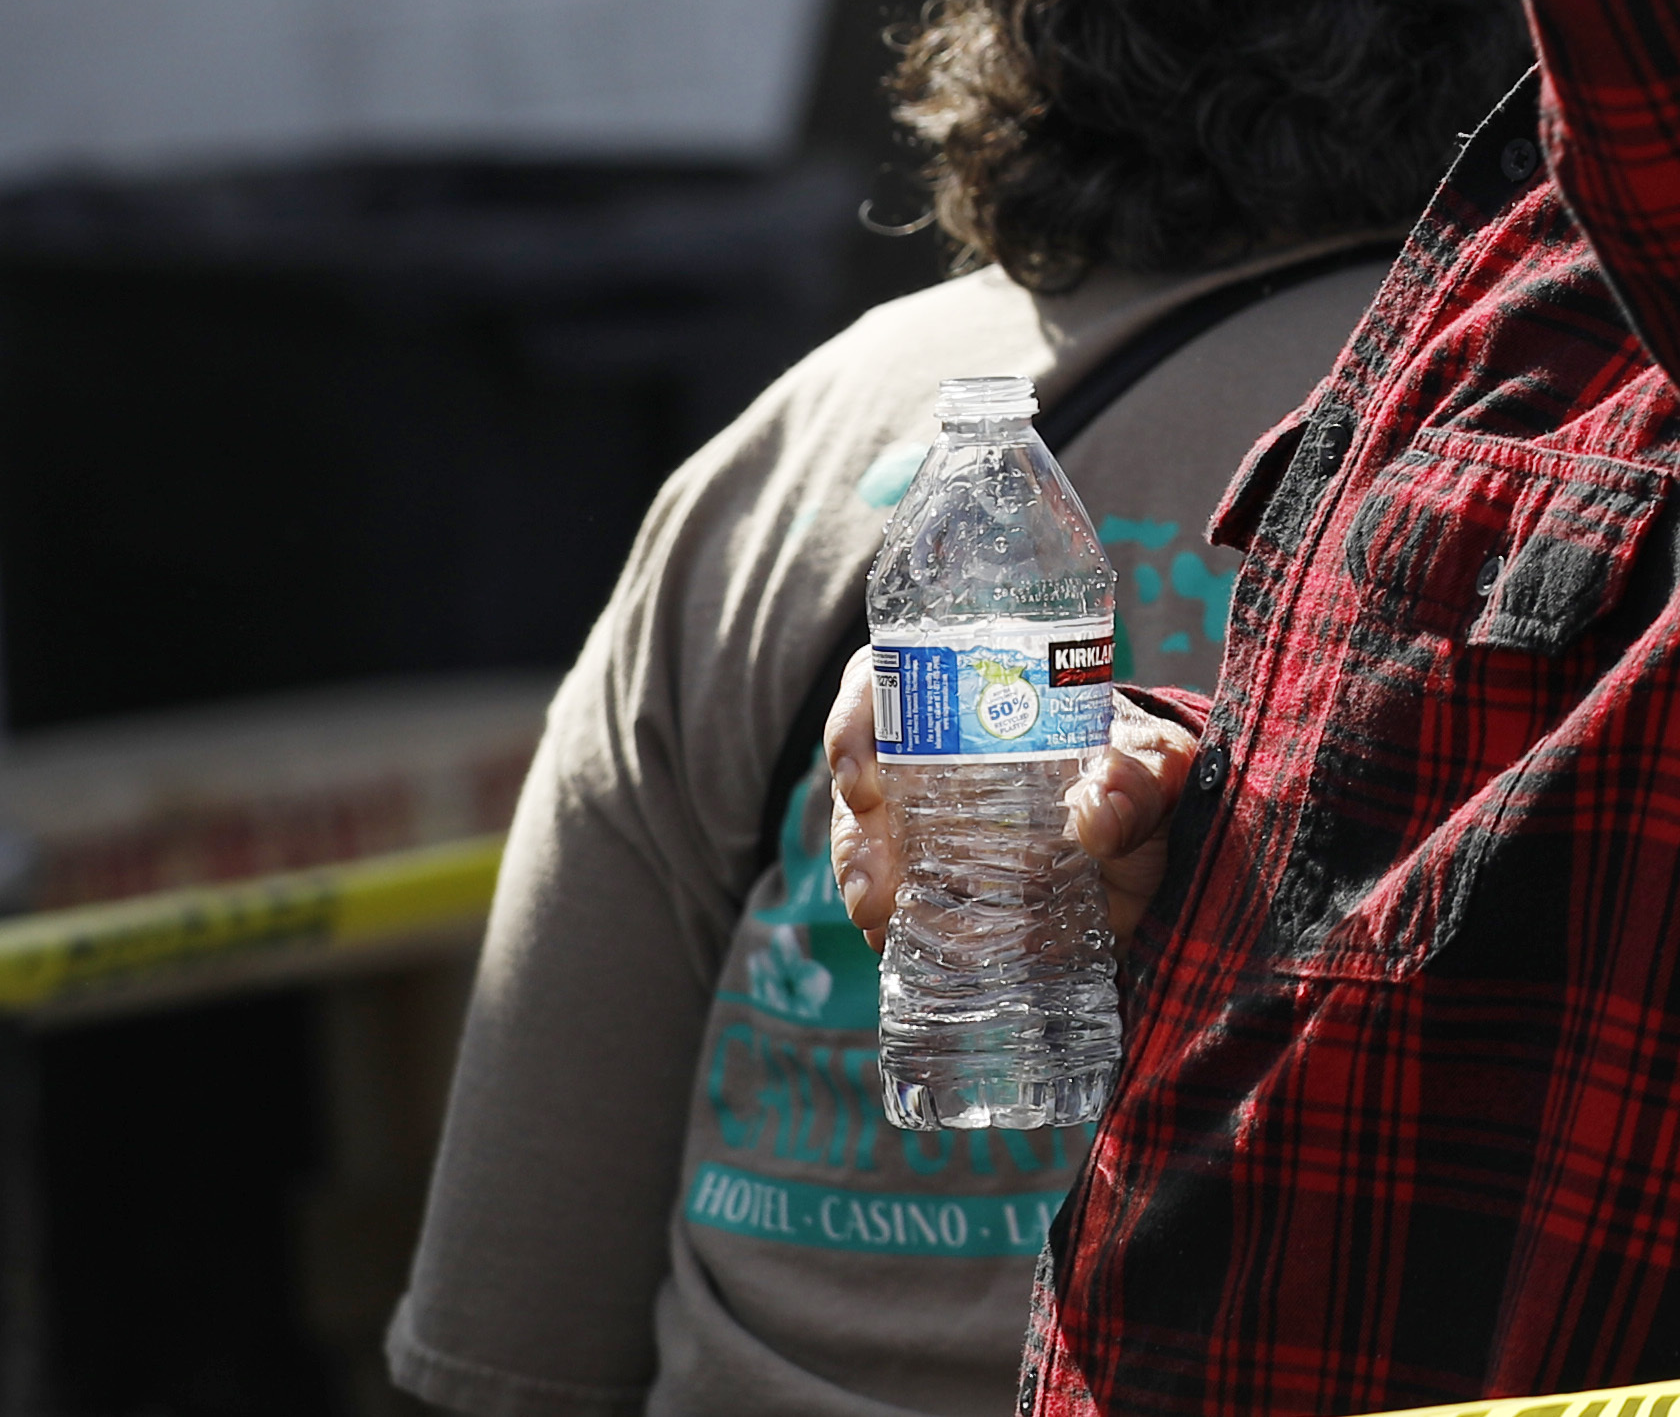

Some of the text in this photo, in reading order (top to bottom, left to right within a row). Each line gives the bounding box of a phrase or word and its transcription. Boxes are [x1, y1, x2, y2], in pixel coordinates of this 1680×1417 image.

[1055, 643, 1116, 670] KIRKLAN
[988, 694, 1029, 721] 50%
[994, 712, 1030, 730] RECYCLED
[1000, 722, 1029, 735] PLASTIC
[695, 1171, 1066, 1247] HOTEL CASINO LA
